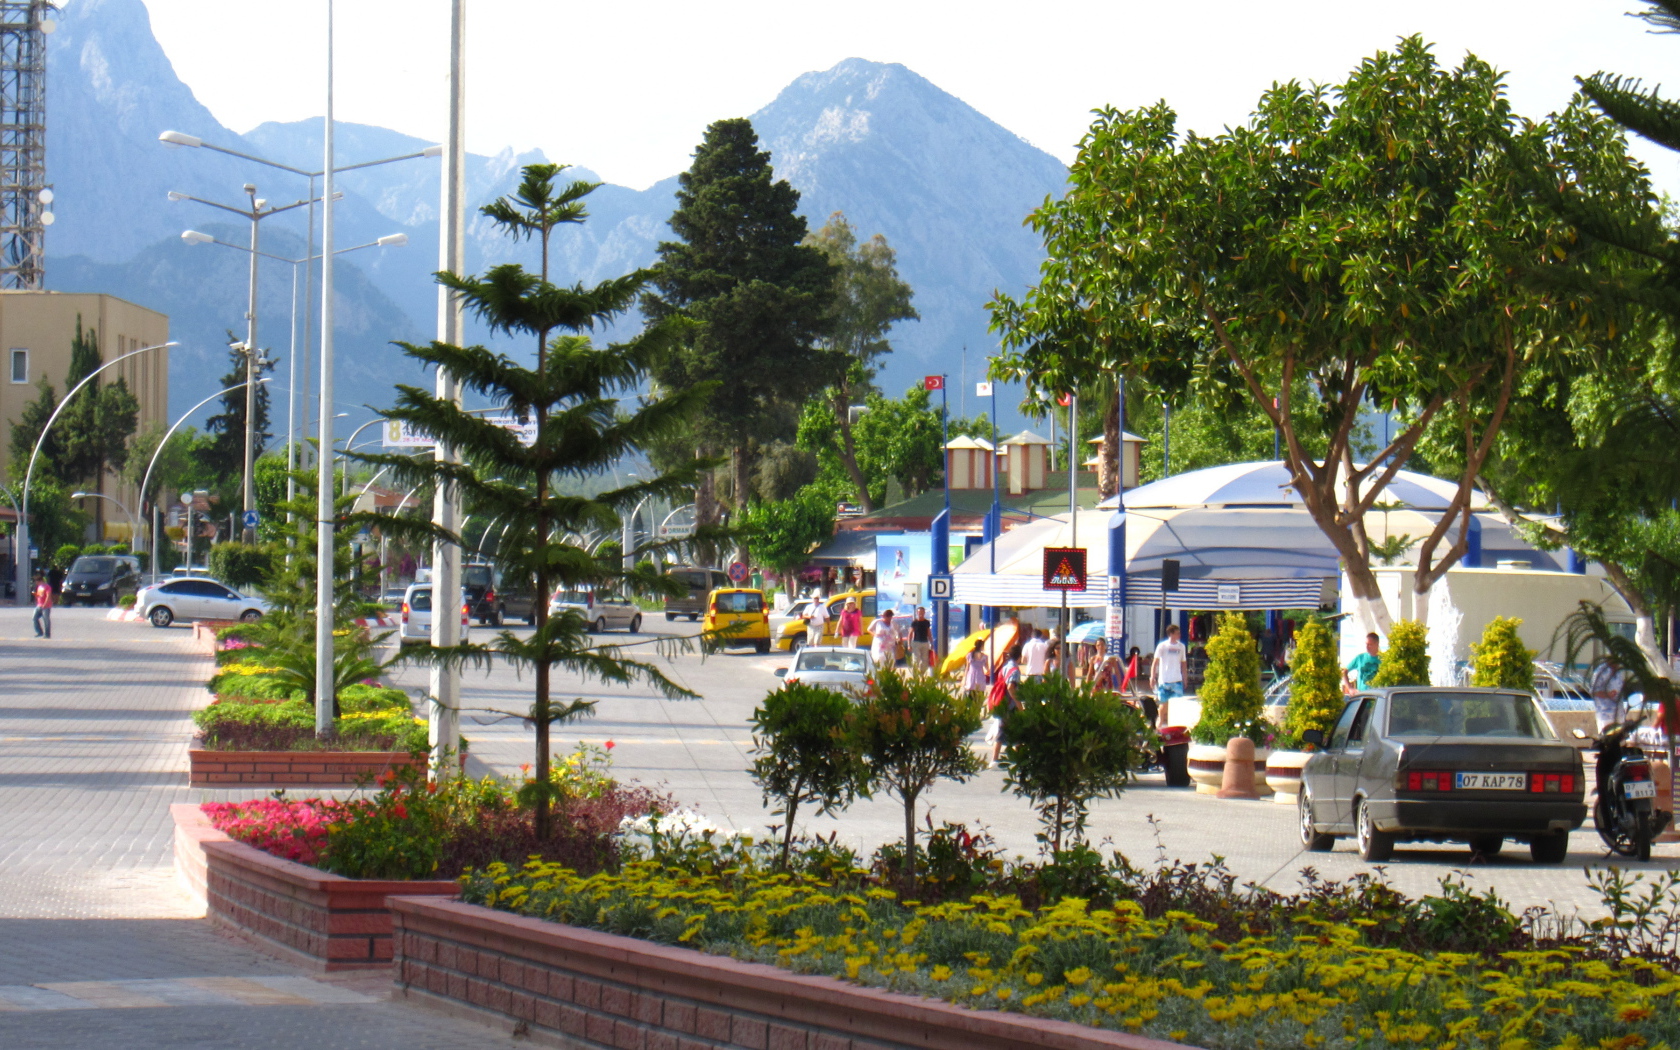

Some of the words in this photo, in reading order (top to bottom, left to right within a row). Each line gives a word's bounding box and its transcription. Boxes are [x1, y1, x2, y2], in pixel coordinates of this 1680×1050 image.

[935, 580, 947, 595] D
[1463, 775, 1478, 787] 07
[1482, 775, 1506, 787] KAP
[1507, 776, 1523, 788] 78
